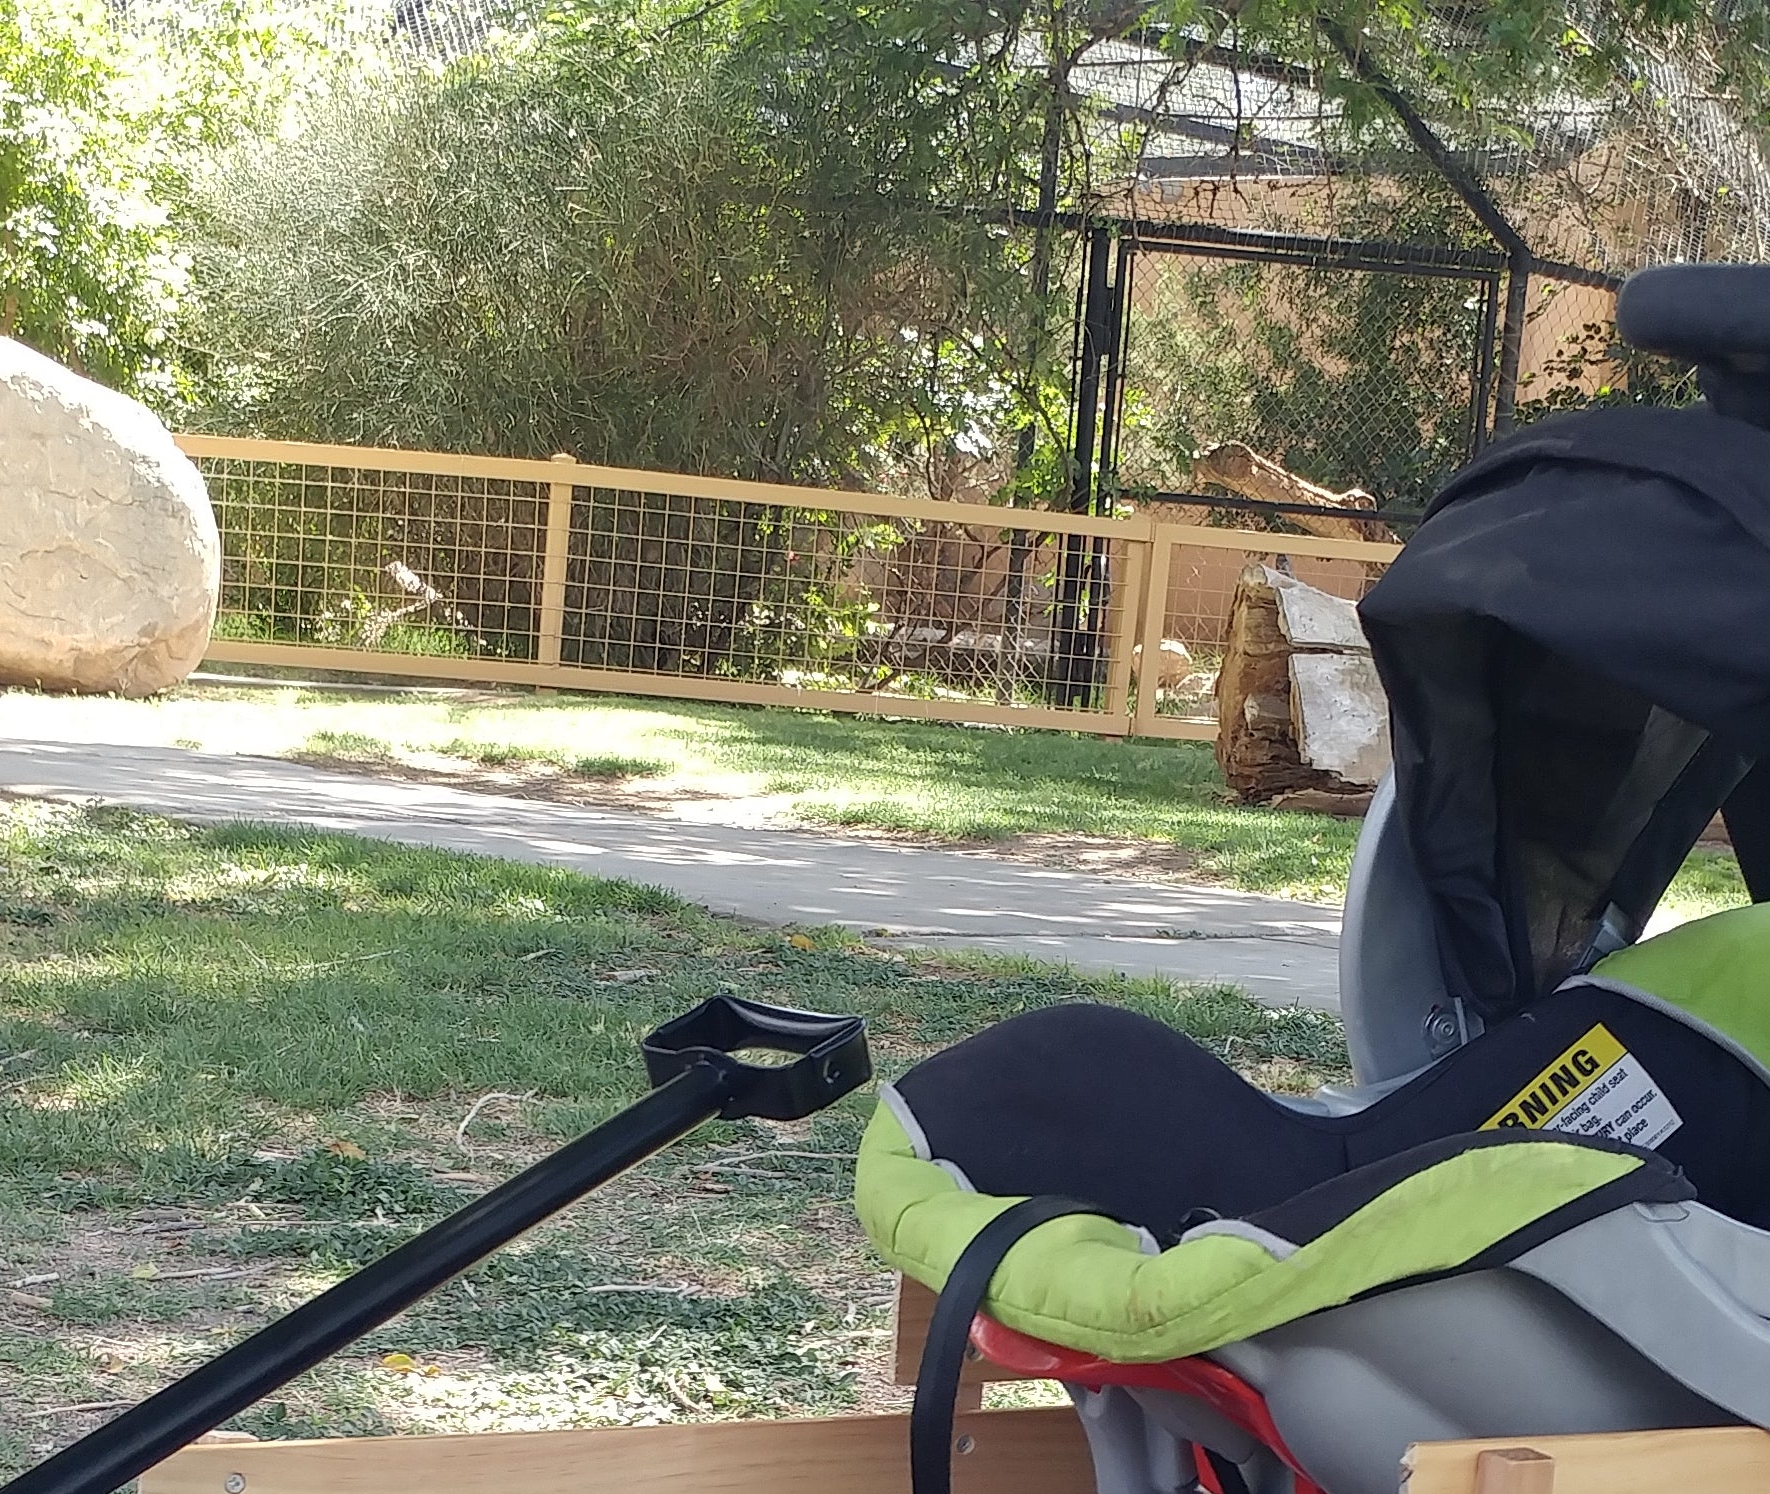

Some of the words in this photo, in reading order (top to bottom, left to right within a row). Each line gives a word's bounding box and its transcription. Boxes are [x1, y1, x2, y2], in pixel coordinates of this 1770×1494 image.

[1497, 1049, 1600, 1129] RNING
[1588, 1084, 1610, 1107] child
[1610, 1067, 1629, 1088] seat
[1615, 1110, 1633, 1128] can
[1624, 1118, 1649, 1142] place
